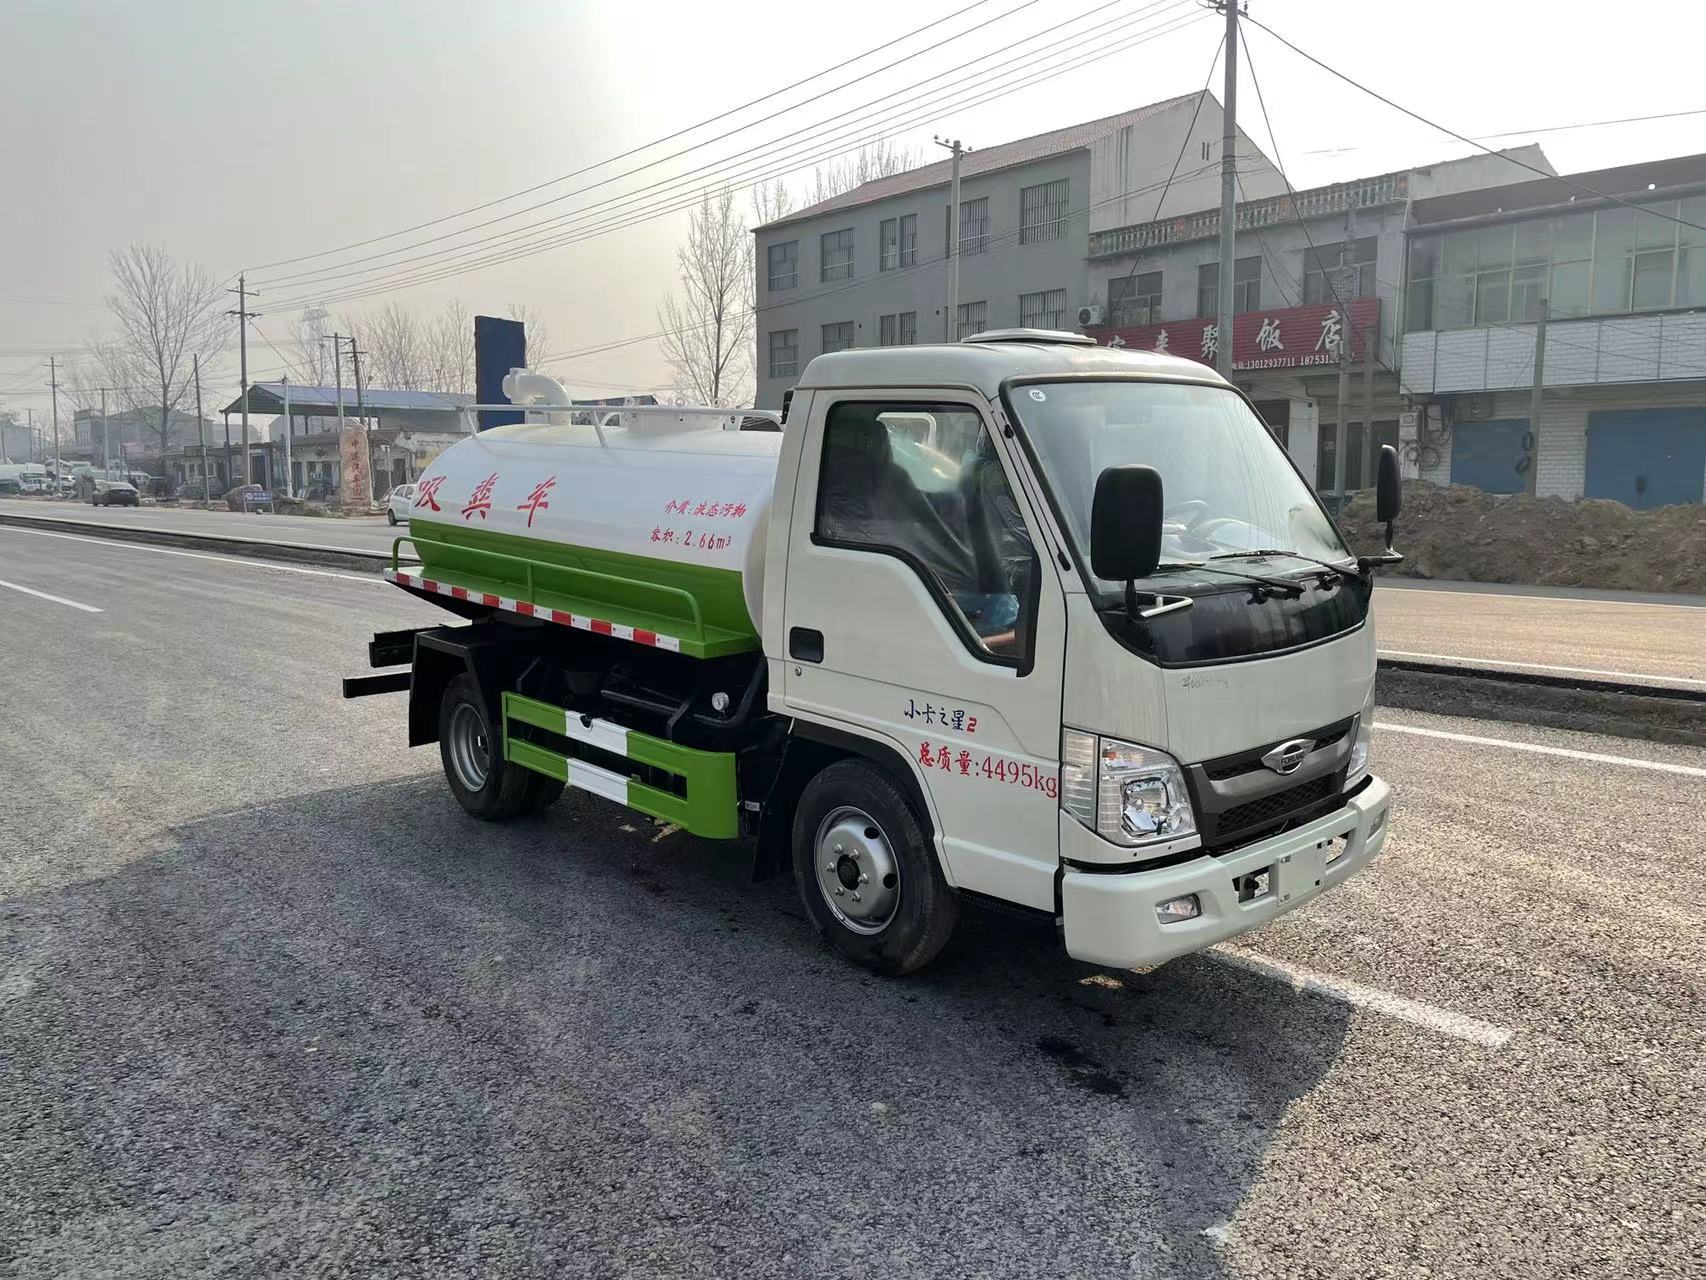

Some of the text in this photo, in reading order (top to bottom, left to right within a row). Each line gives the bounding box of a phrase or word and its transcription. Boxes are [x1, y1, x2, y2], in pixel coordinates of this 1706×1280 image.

[904, 699, 977, 733] 小卡之星2
[918, 741, 1058, 799] 总质量:4495kg
